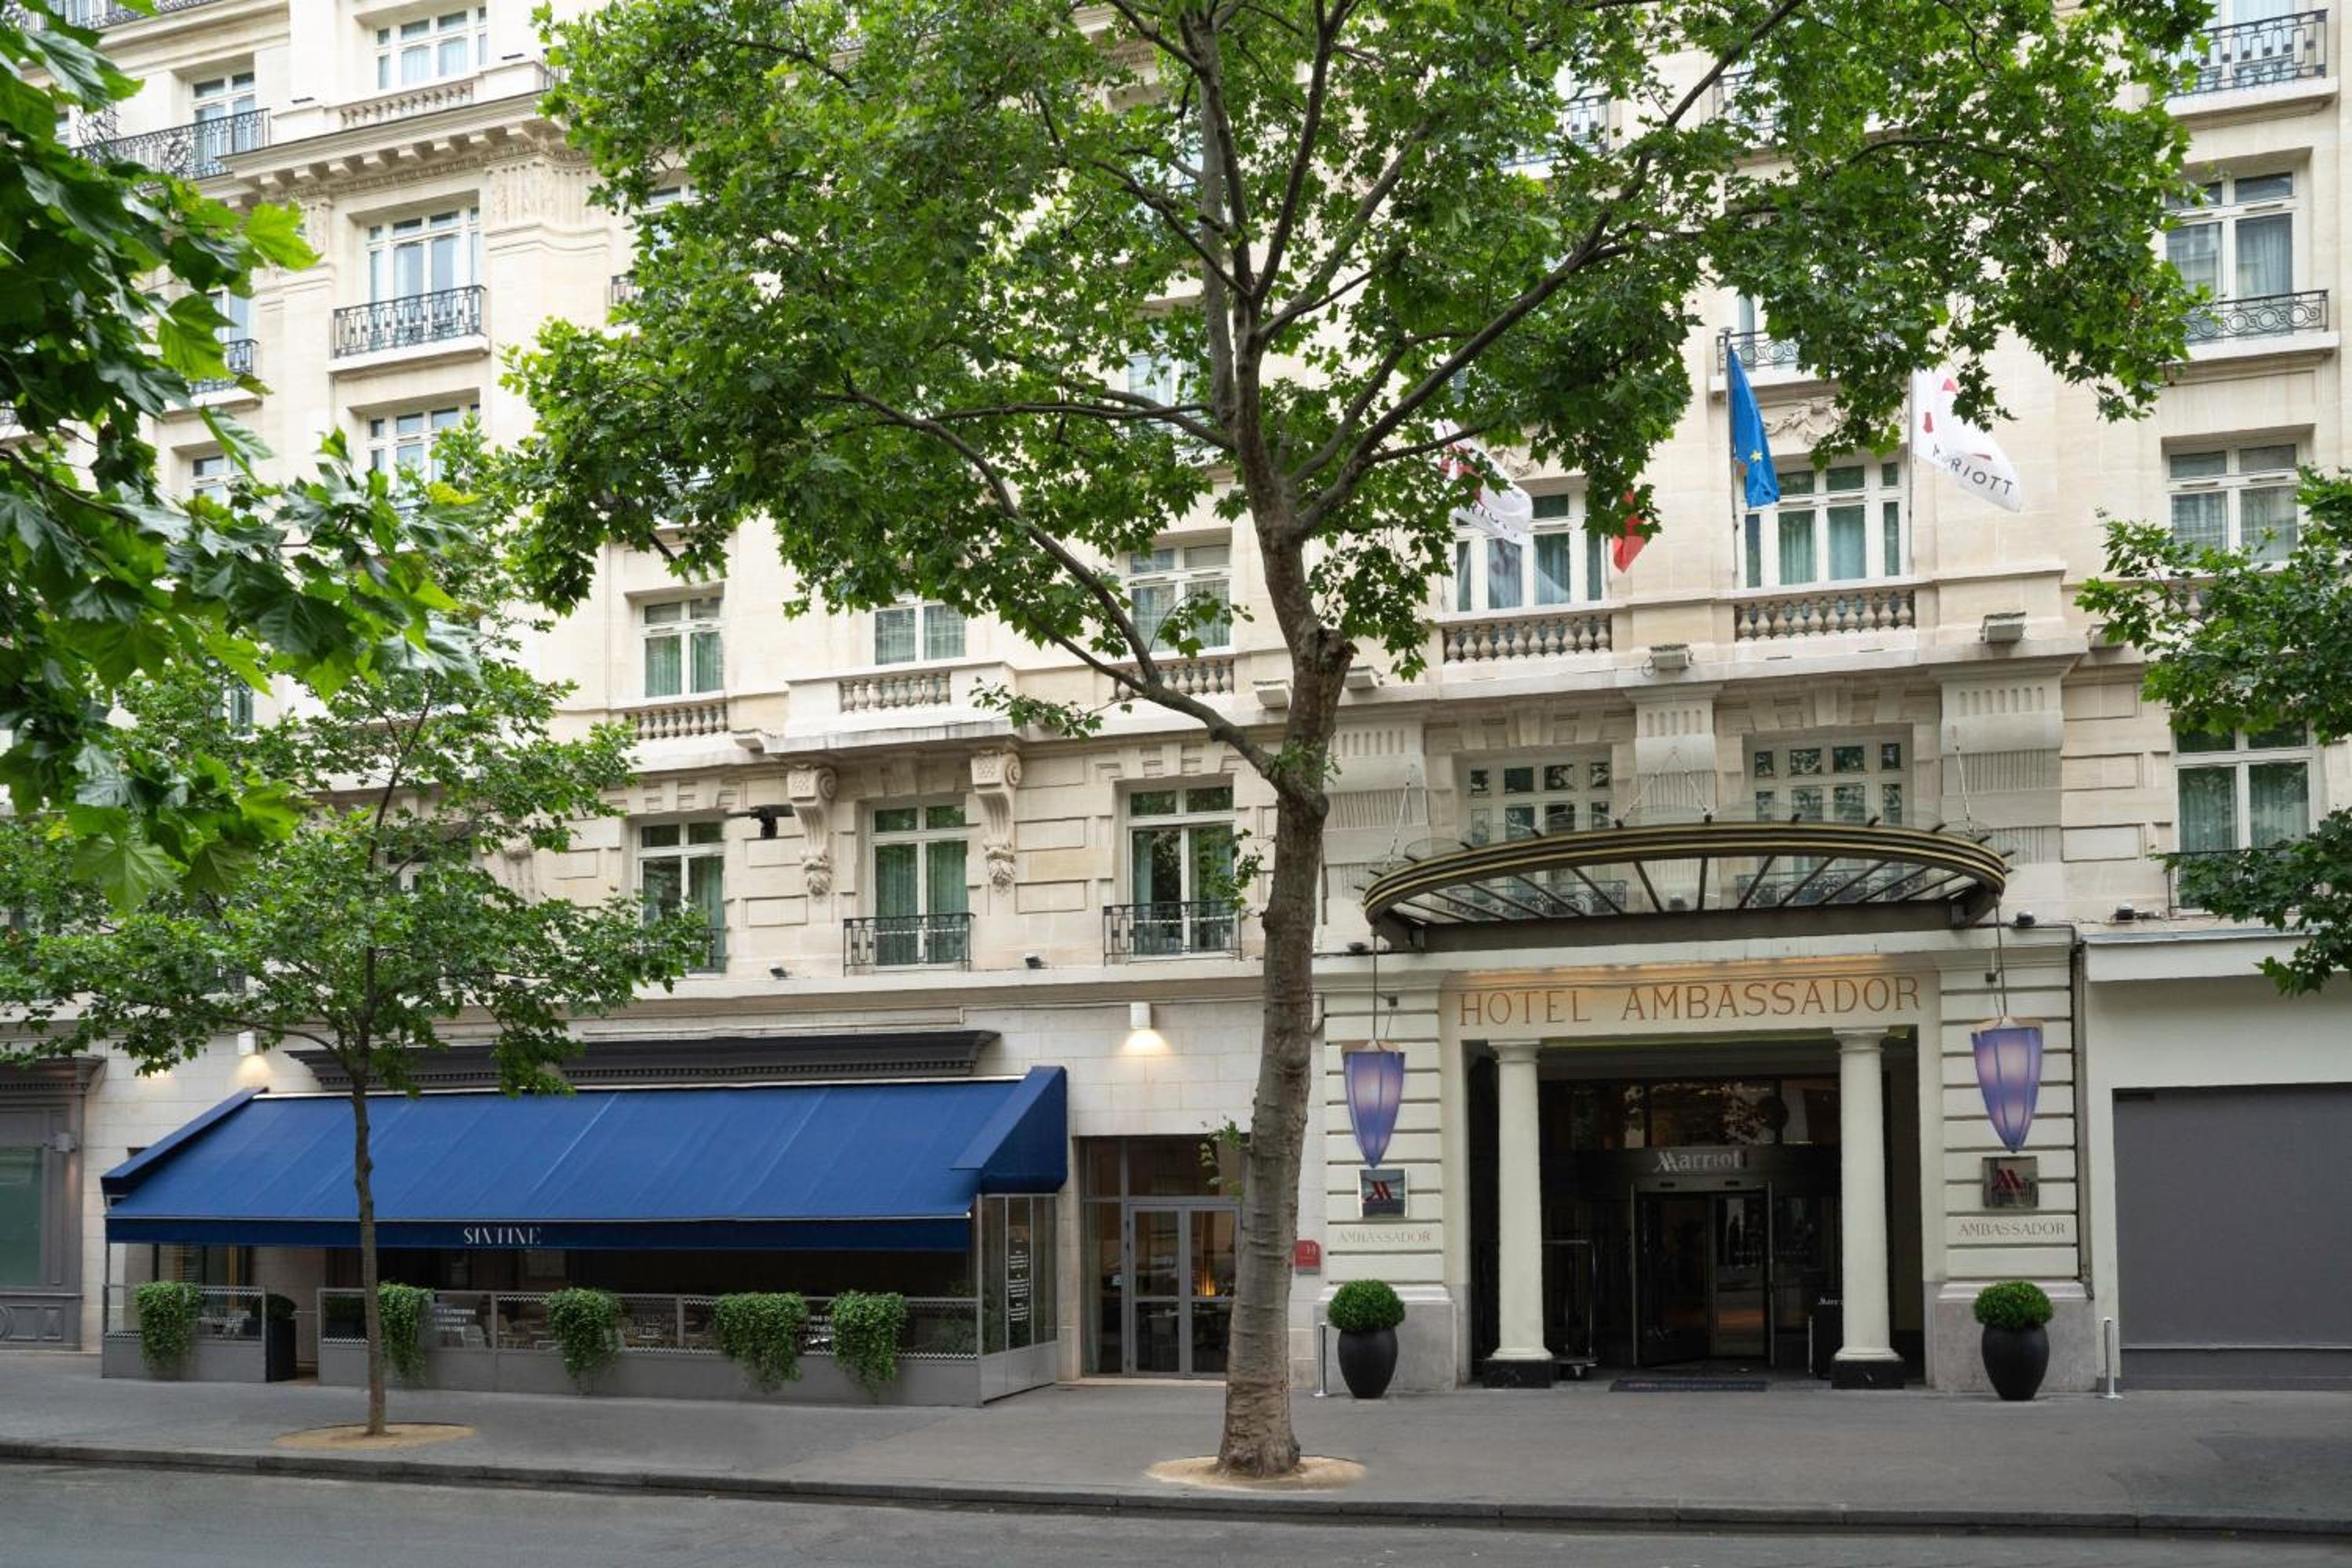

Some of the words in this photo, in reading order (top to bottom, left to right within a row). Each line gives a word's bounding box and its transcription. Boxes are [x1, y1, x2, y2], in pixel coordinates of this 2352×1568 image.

[1459, 989, 1592, 1027] HOTEL
[1621, 976, 1921, 1022] AMBASSADOR
[463, 1227, 541, 1244] SIXTINE
[1338, 1229, 1431, 1243] AMBASSADOR
[1958, 1221, 2066, 1236] AMBASSADOR
